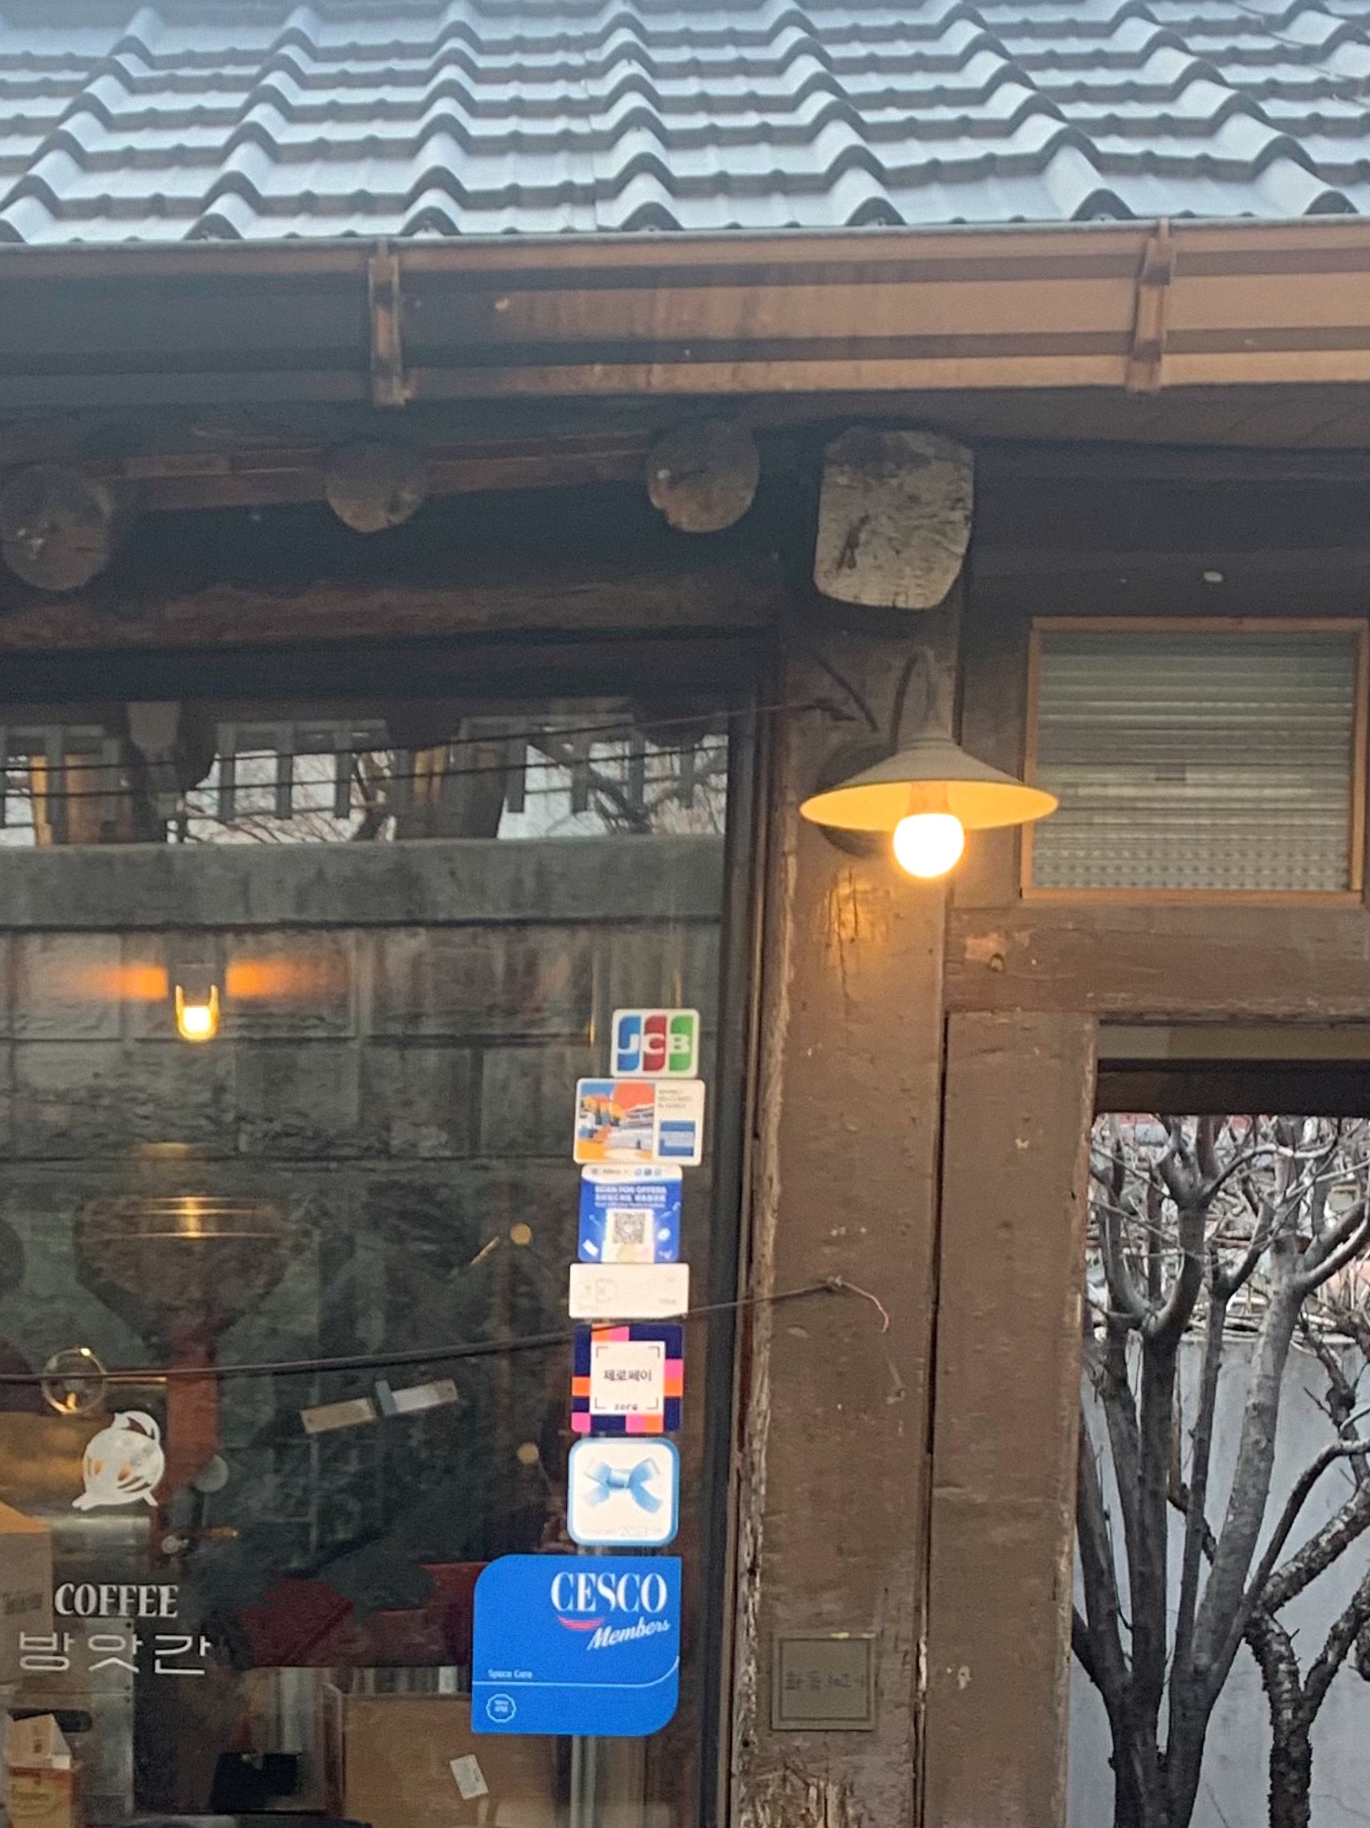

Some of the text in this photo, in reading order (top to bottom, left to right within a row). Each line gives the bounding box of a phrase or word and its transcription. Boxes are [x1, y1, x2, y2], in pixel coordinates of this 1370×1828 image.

[603, 1369, 652, 1382] 제로페이
[54, 1583, 179, 1618] COFFEE
[550, 1571, 667, 1612] CESCO
[586, 1616, 670, 1650] Members
[19, 1631, 211, 1675] 방앗간
